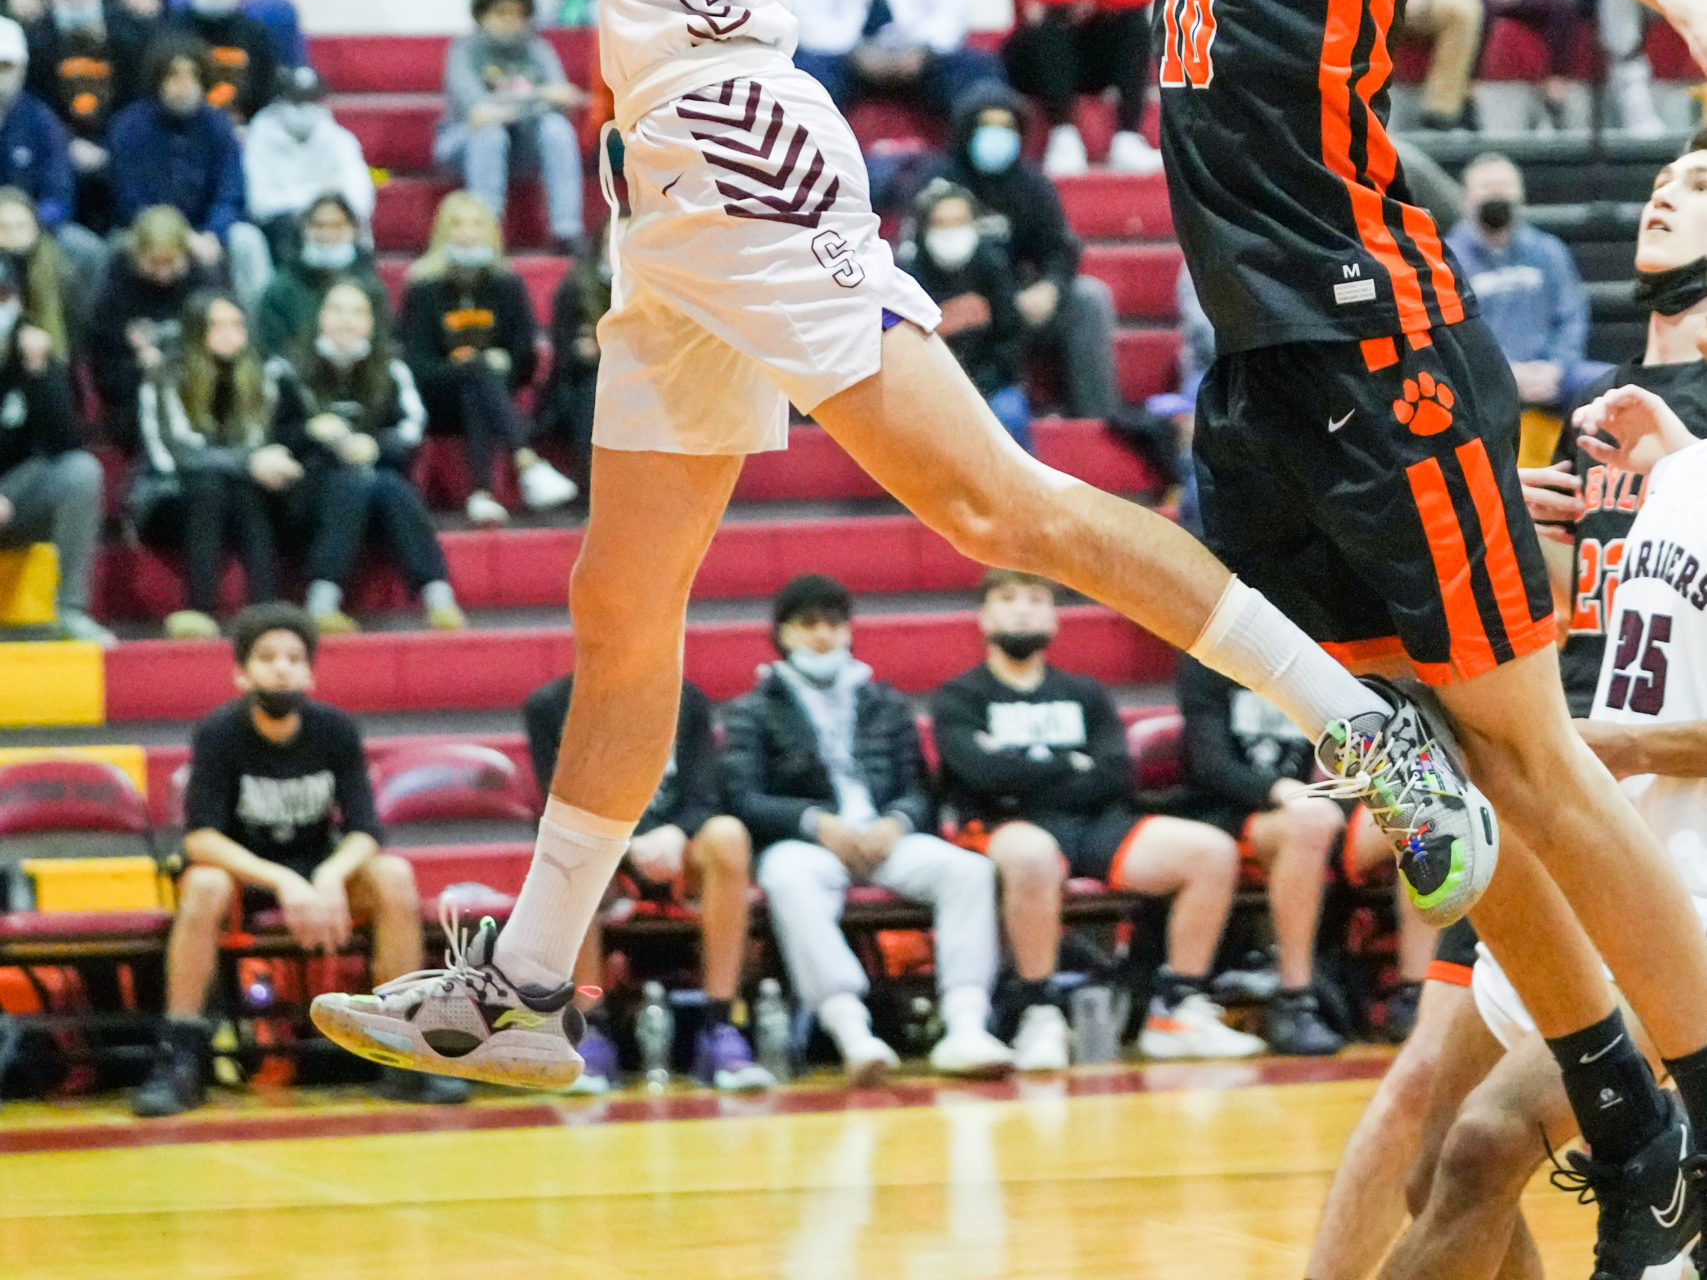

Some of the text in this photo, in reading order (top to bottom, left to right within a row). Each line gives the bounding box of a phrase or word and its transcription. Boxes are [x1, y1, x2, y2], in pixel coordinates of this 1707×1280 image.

[811, 229, 865, 288] S
[1342, 263, 1361, 279] M
[1605, 608, 1672, 716] 25
